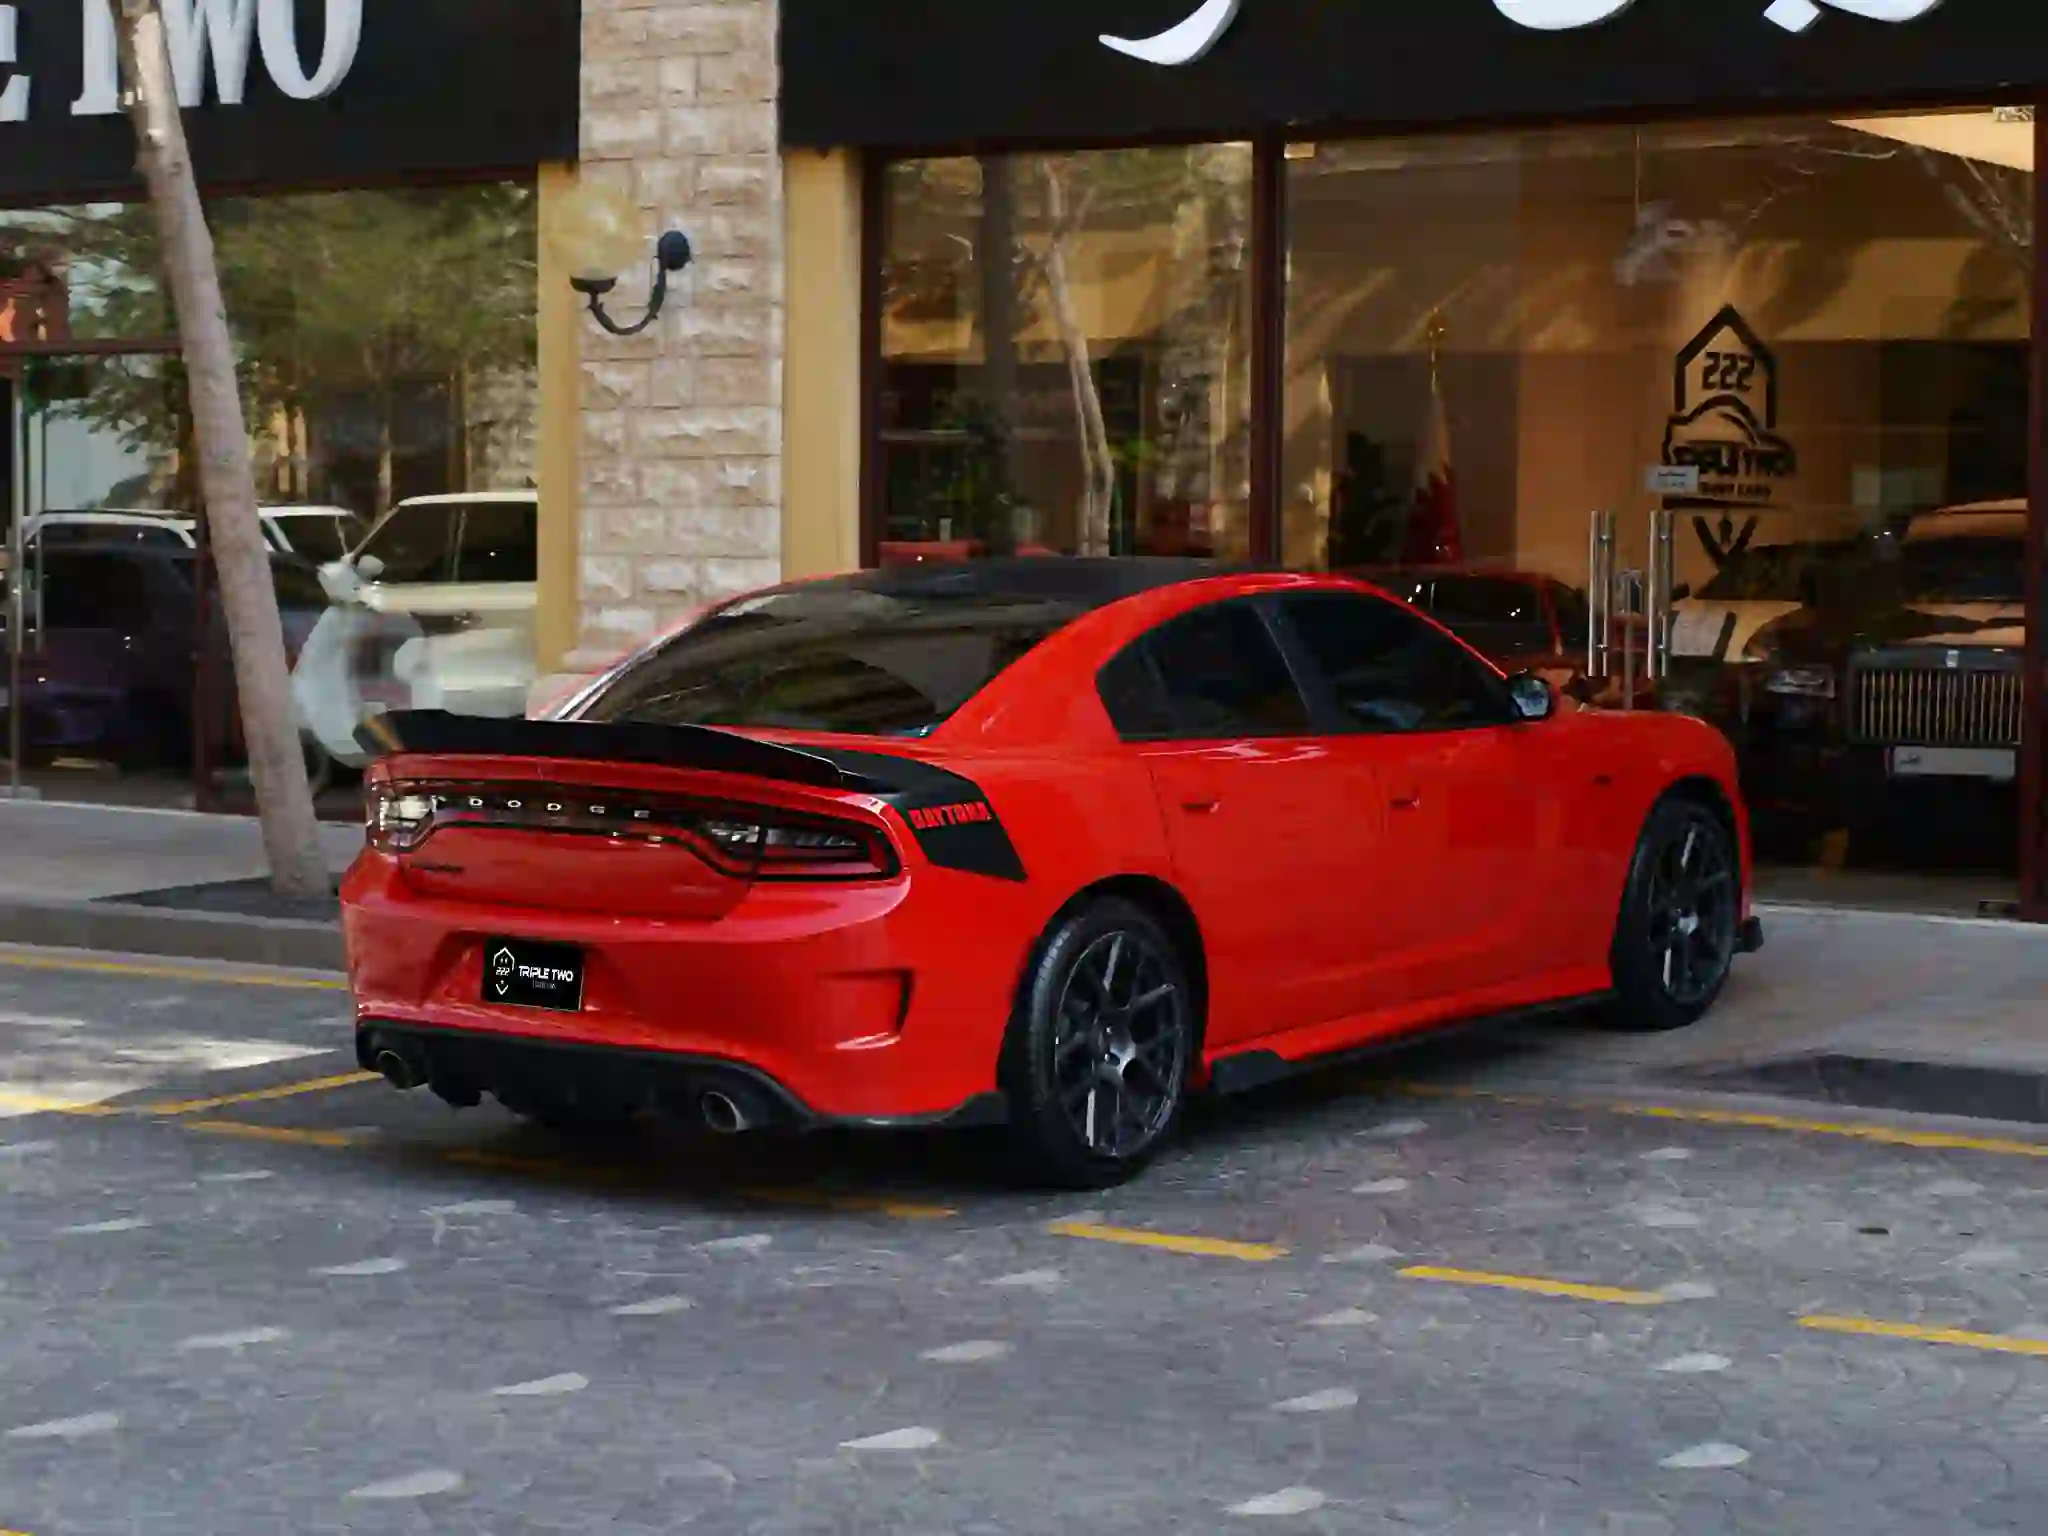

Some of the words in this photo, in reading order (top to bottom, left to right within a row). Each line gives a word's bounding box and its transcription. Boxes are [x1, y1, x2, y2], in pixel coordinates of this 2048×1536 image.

[1703, 351, 1755, 392] 222
[469, 797, 649, 818] DODGE
[519, 966, 549, 979] TRIPLE
[552, 969, 573, 981] TWO
